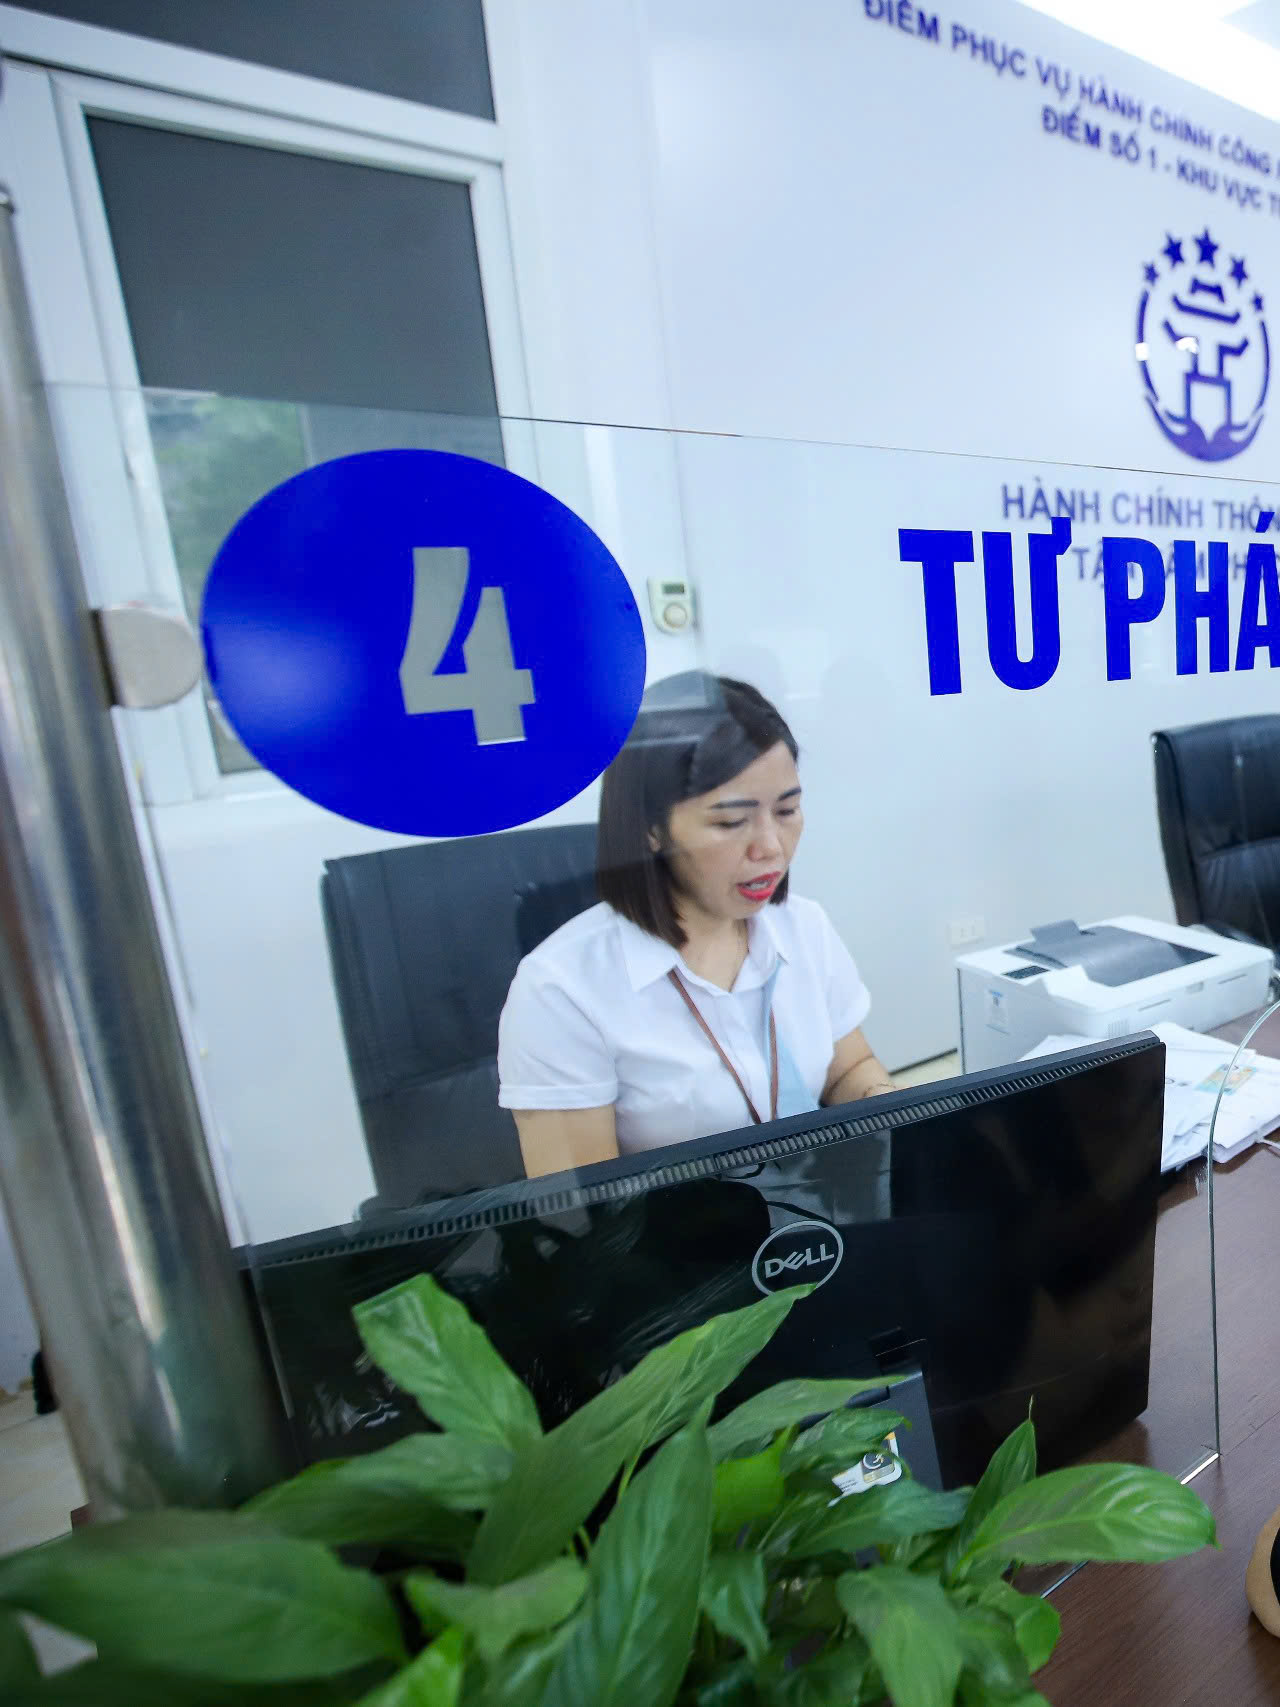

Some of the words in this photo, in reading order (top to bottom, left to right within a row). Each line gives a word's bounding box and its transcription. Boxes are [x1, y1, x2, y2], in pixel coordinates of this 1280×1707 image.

[952, 23, 1026, 77] PHỤC
[1036, 56, 1070, 99] VỤ
[1079, 75, 1142, 123] HÀNH
[1218, 135, 1271, 175] CÔNG
[1109, 131, 1140, 164] SỐ
[1150, 146, 1156, 171] 1
[1177, 155, 1217, 193] KHU
[1001, 477, 1101, 523] HÀNH
[1112, 486, 1205, 528] CHÍNH
[400, 546, 536, 745] 4
[898, 516, 1072, 697] TƯ
[765, 1243, 834, 1278] DELL
